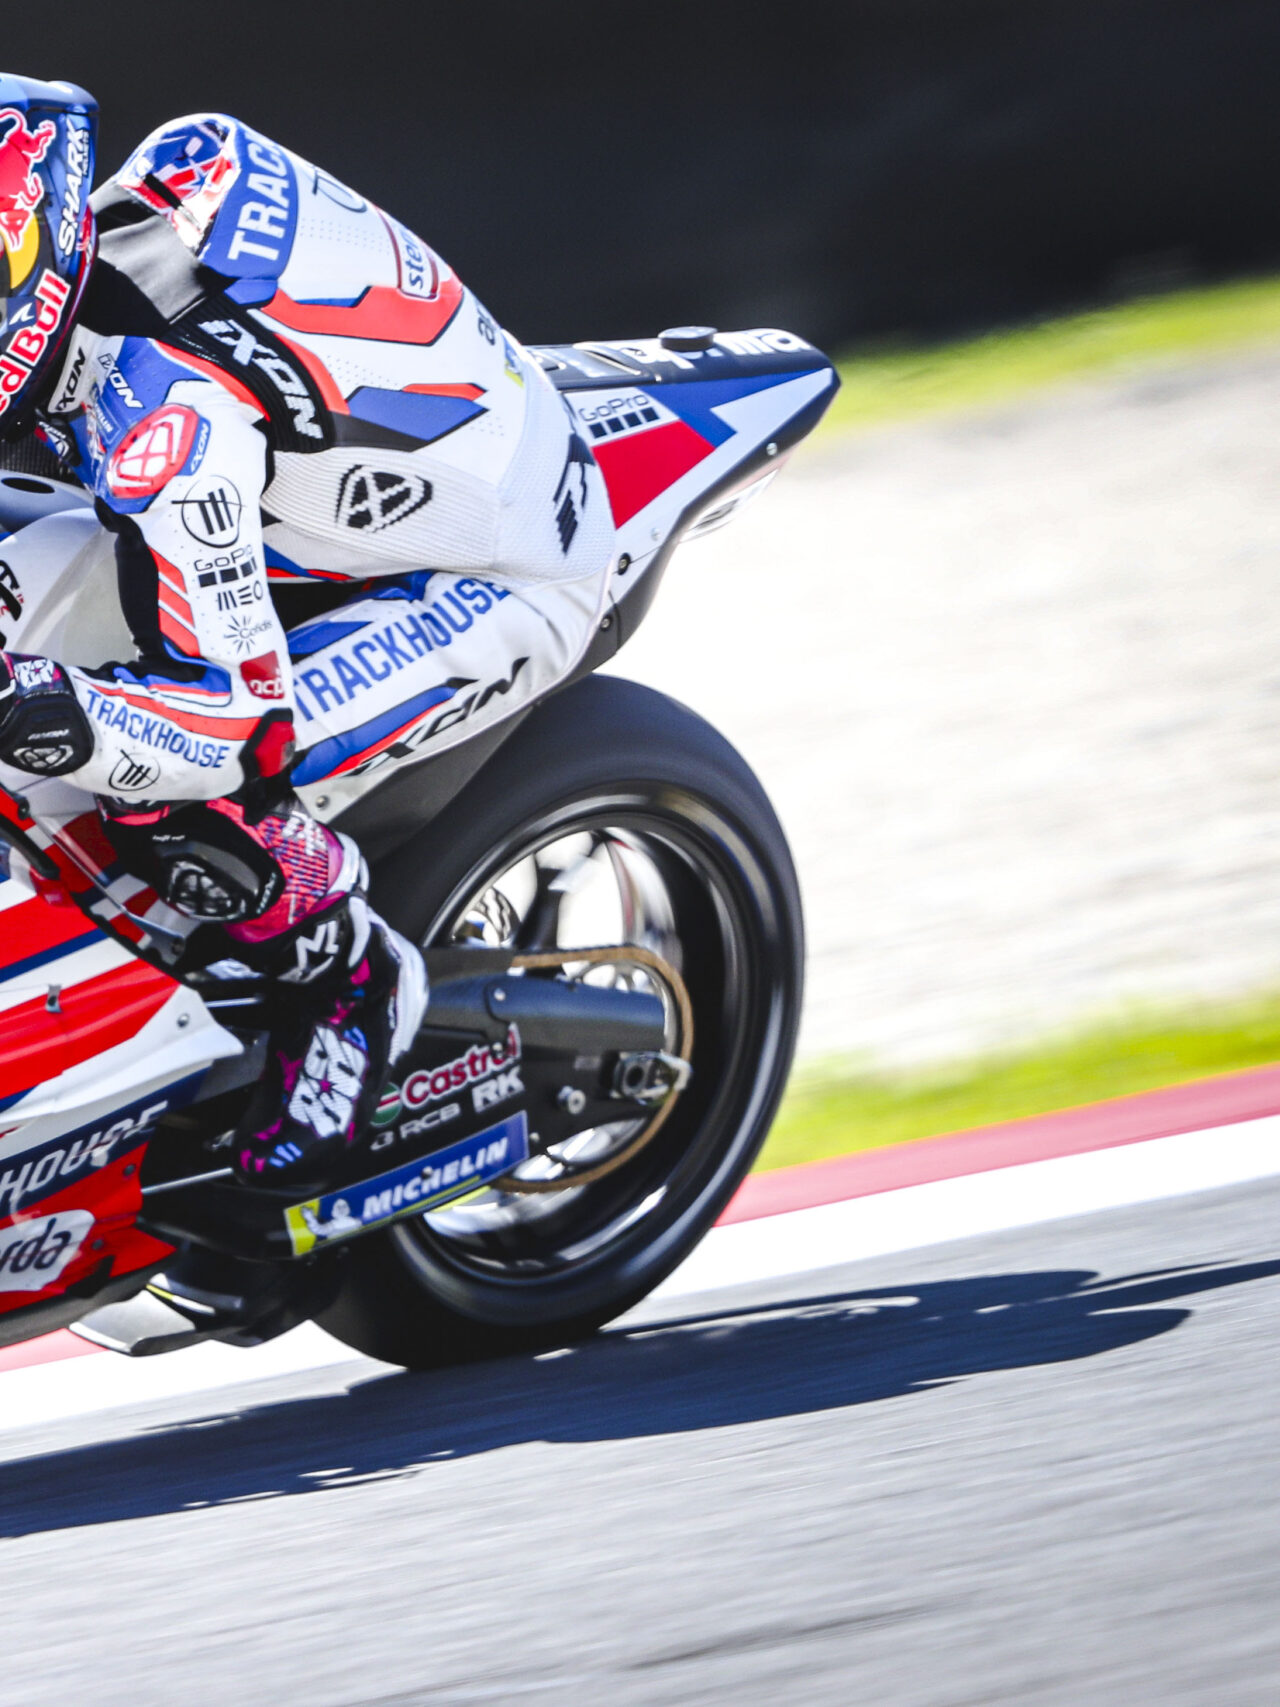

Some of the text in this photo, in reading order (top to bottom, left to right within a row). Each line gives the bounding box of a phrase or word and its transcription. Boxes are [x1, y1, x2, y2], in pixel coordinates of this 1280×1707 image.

[58, 115, 84, 256] SHARK
[13, 271, 70, 366] Bull
[577, 393, 650, 423] GoPro
[292, 579, 513, 722] TRACKHOUSE
[86, 688, 230, 768] TRACKHOUSE
[472, 1065, 524, 1113] RK
[361, 1136, 508, 1220] MICHELIN
